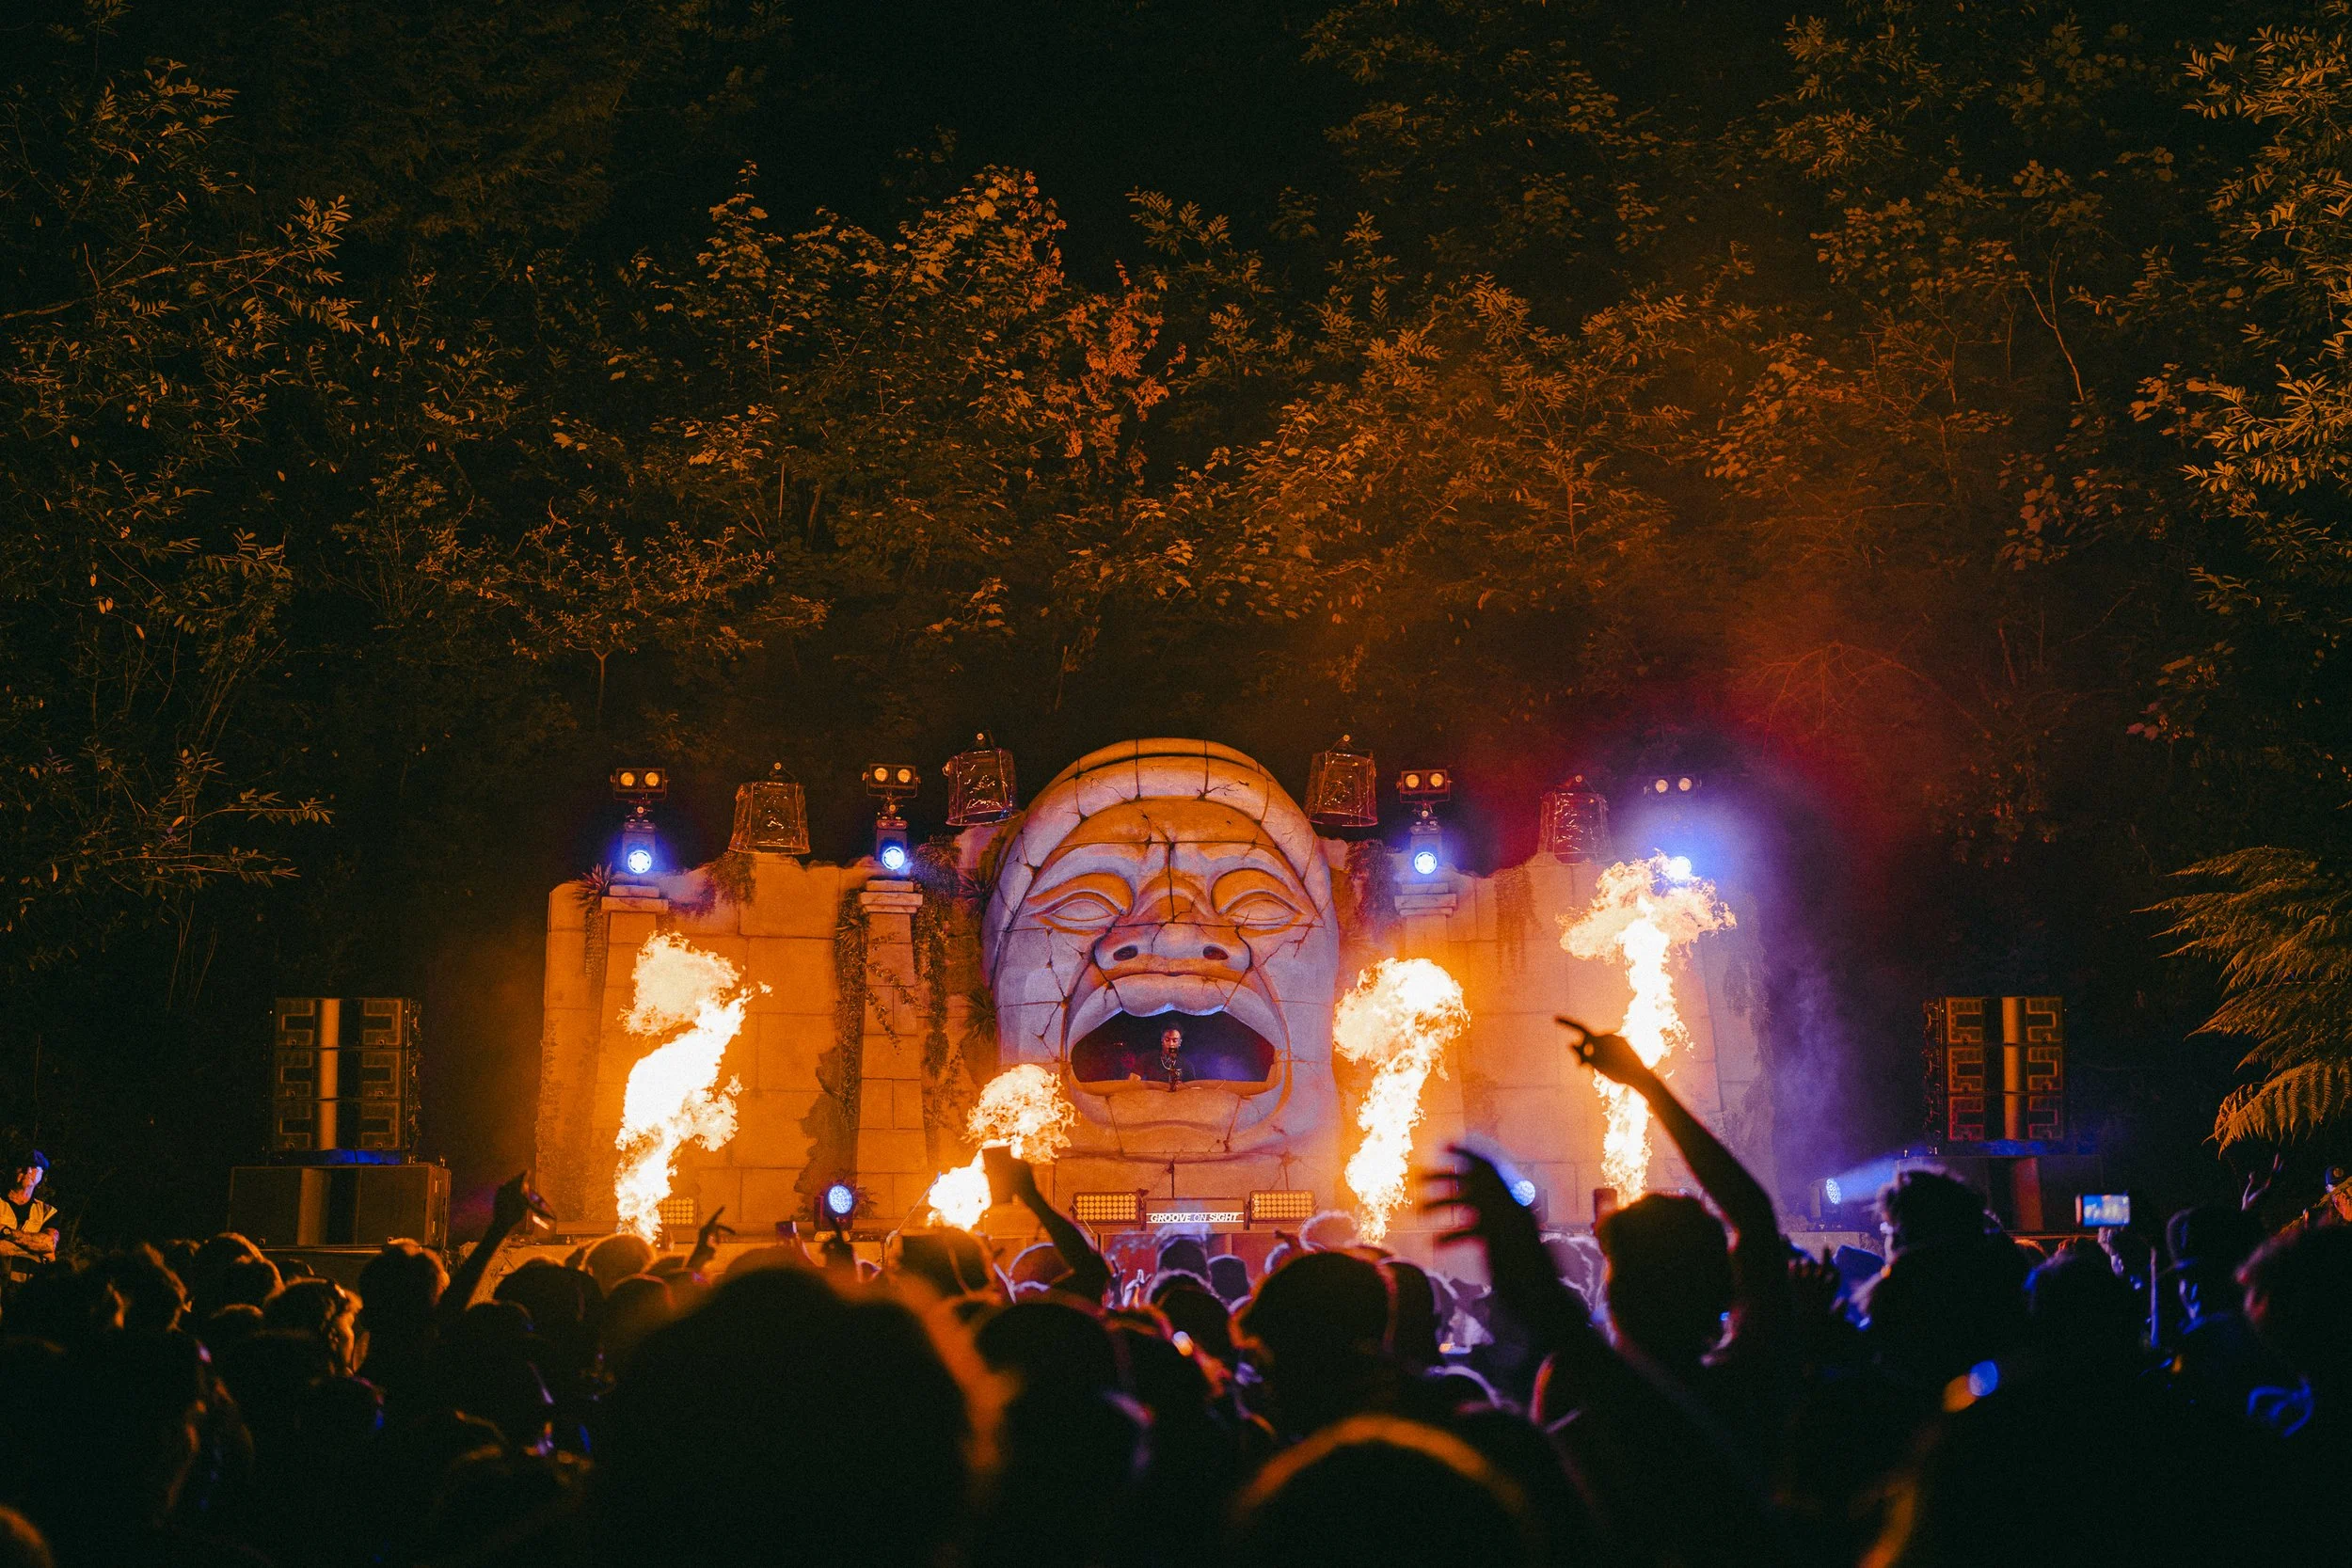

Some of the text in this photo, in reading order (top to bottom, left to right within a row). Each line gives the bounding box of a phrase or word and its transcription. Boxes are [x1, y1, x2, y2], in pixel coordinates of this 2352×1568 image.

[1150, 1212, 1239, 1223] GROOVE ON SIGHT
